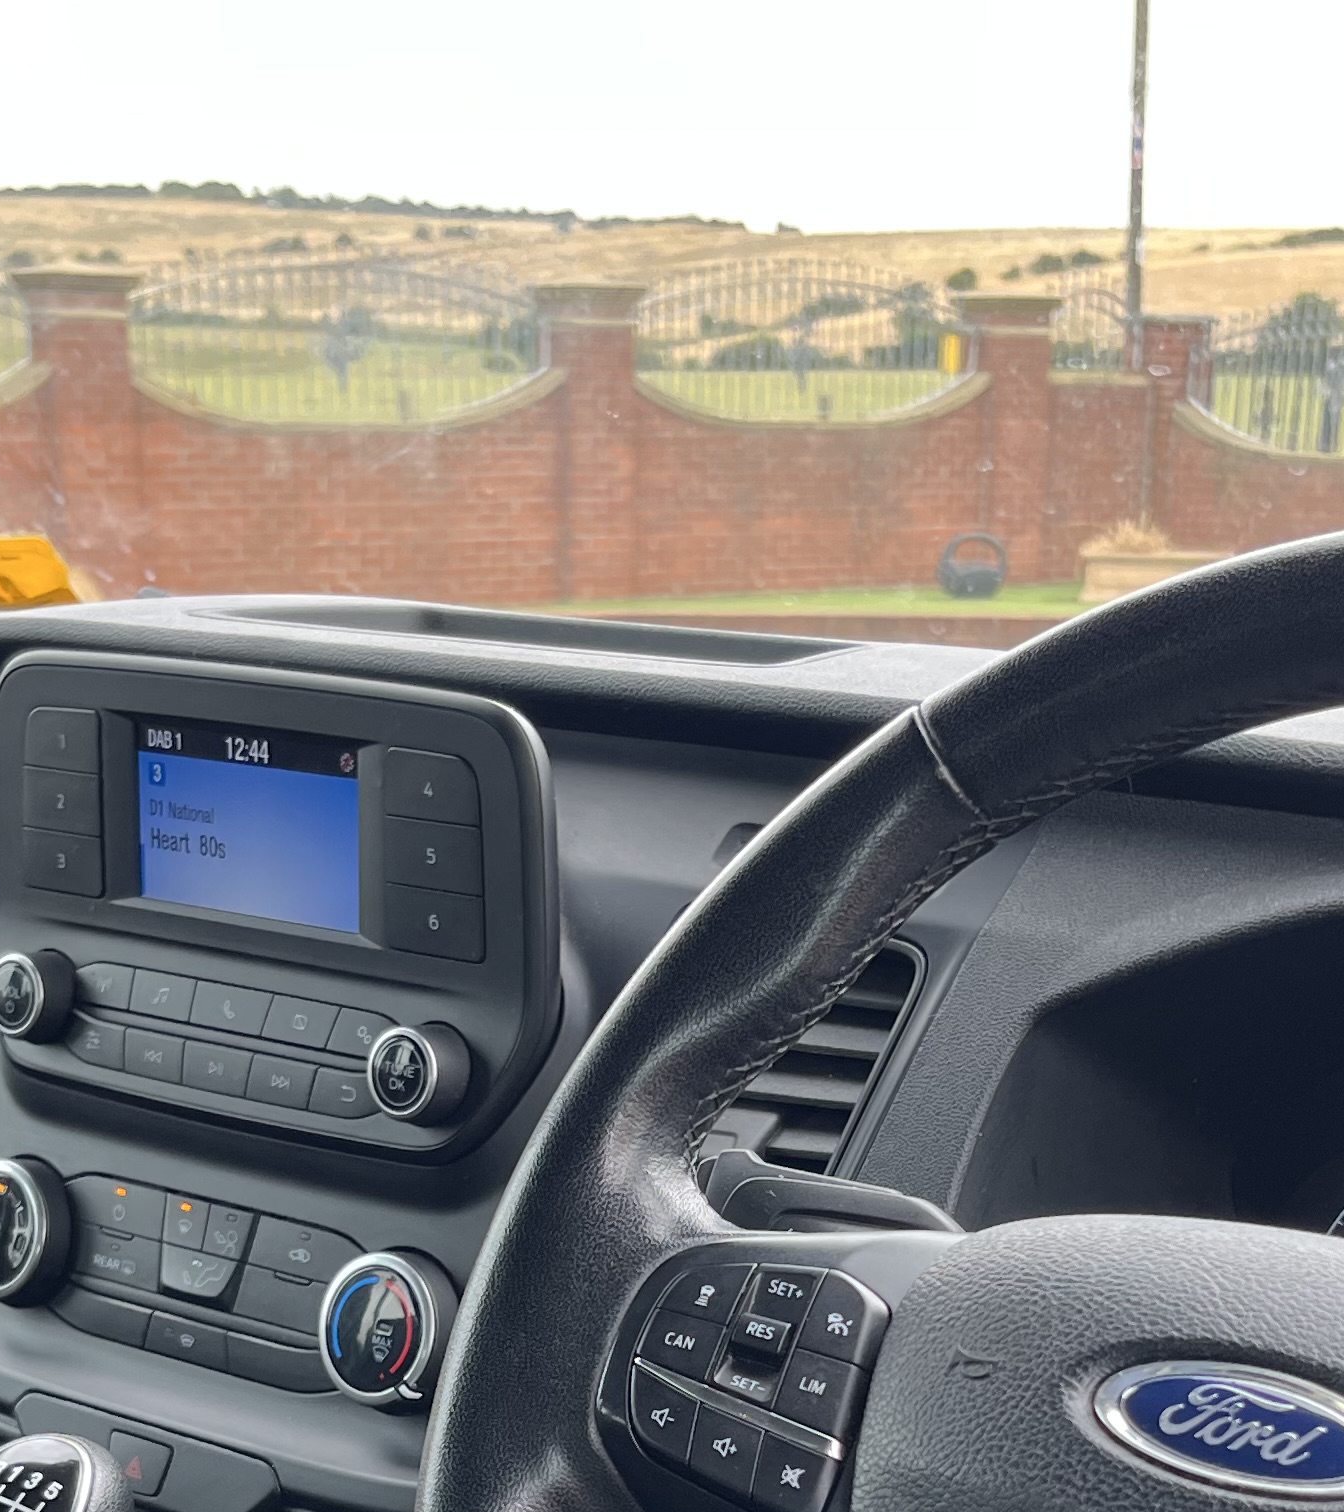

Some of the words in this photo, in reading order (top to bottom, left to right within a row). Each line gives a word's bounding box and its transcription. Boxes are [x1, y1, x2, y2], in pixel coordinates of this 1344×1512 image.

[147, 728, 173, 749] DAB
[175, 733, 182, 751] 1
[224, 736, 270, 764] 12:44
[152, 763, 162, 783] 3
[423, 782, 433, 798] 4
[56, 793, 65, 809] 2
[150, 798, 164, 818] D1
[168, 801, 215, 825] National
[150, 826, 191, 854] Heart
[199, 834, 227, 859] 80s
[56, 853, 66, 869] 3
[426, 848, 437, 864] 5
[429, 914, 440, 930] 6
[385, 1060, 416, 1079] TUNE
[388, 1077, 405, 1092] OK
[93, 1252, 120, 1270] REAR
[767, 1278, 805, 1300] SET+
[663, 1330, 696, 1351] CAN
[745, 1320, 776, 1341] RES
[371, 1334, 393, 1349] MAX
[729, 1373, 766, 1394] SET-
[798, 1376, 827, 1397] LIM
[1157, 1382, 1330, 1468] Ford
